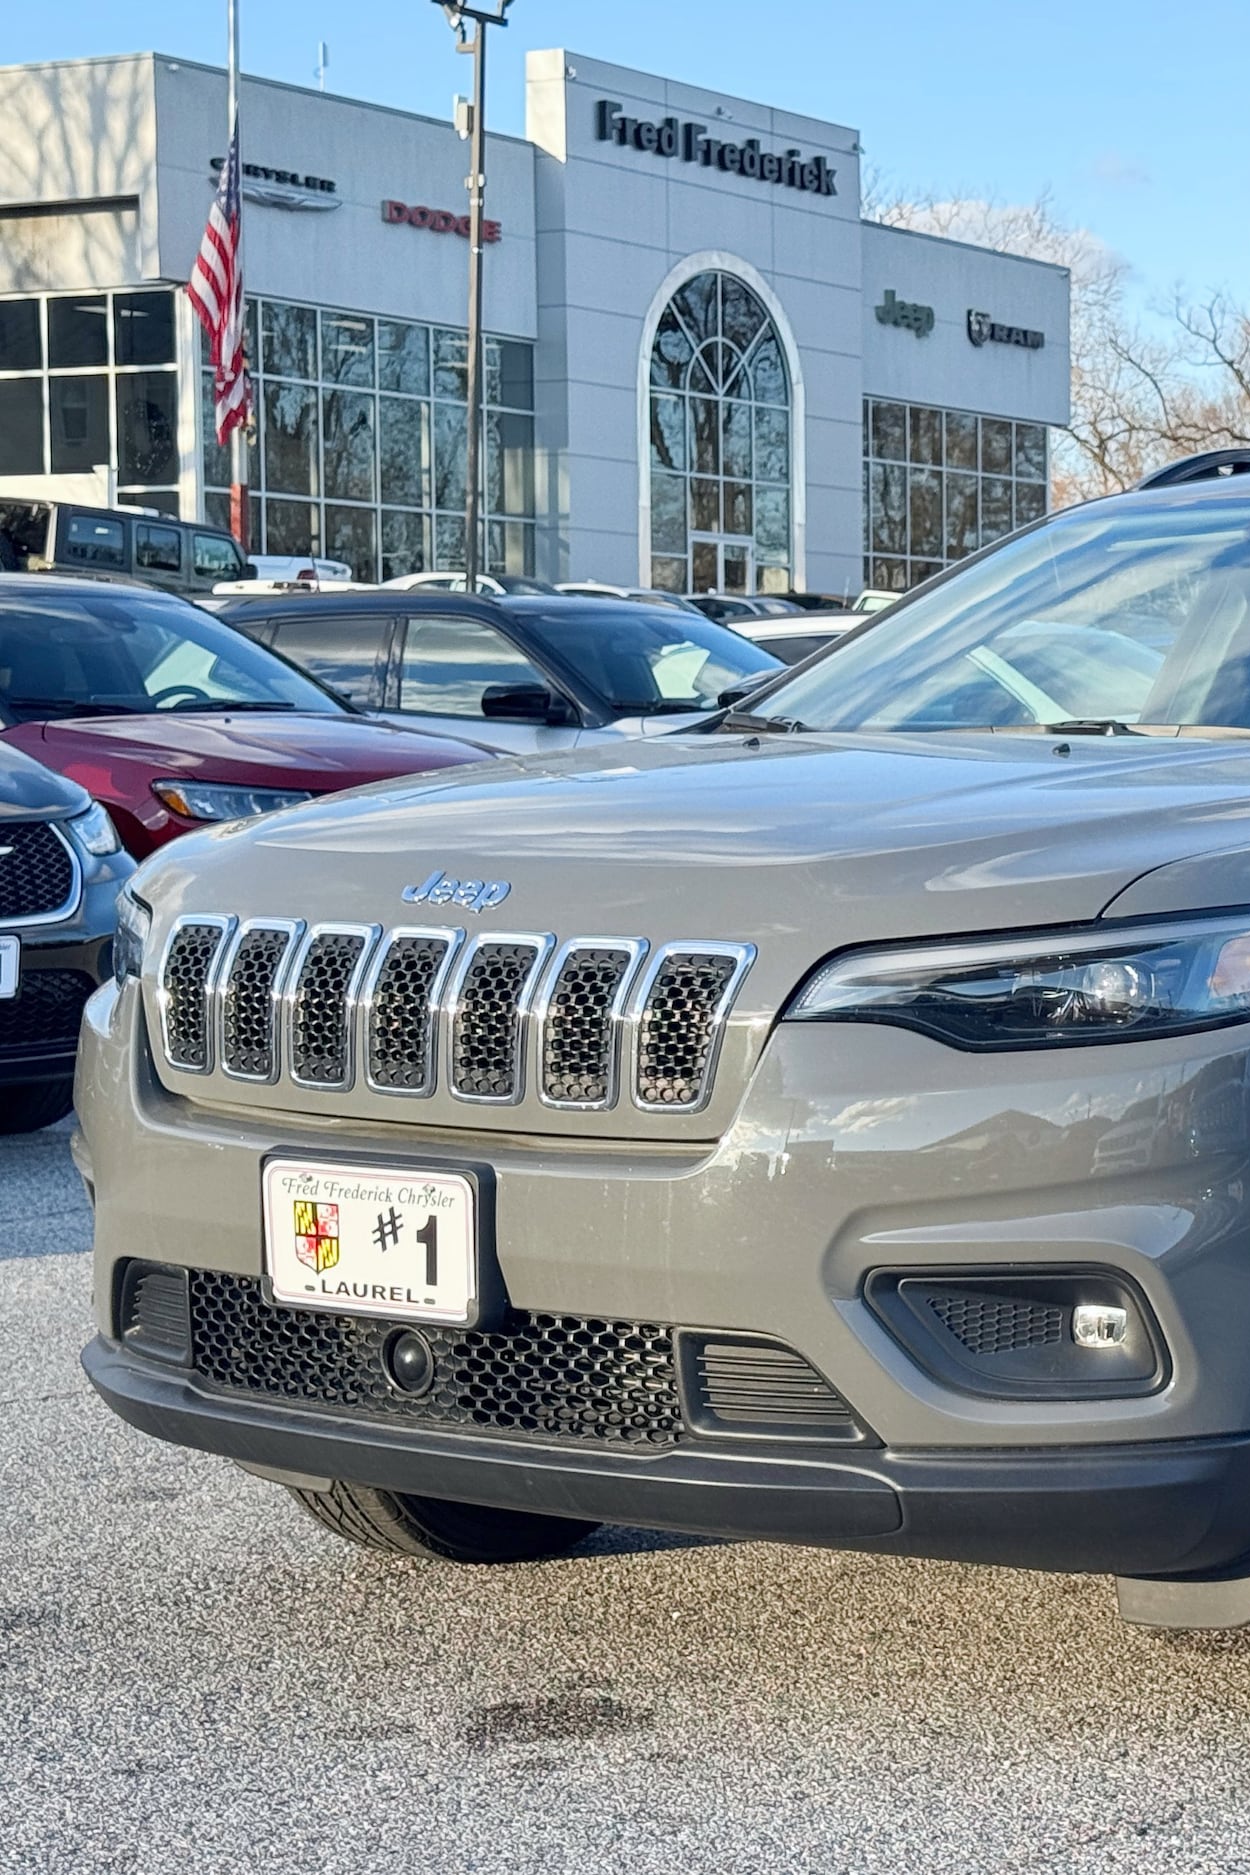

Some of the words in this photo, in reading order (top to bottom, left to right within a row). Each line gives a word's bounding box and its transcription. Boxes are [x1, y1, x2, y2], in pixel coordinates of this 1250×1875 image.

[595, 99, 679, 158] Fred
[681, 122, 837, 196] Frederick
[210, 157, 337, 193] CRYSLER
[381, 199, 502, 243] DODGE
[875, 289, 935, 338] Jeep
[990, 322, 1045, 350] RAM
[401, 869, 513, 914] Jeep
[282, 1176, 320, 1197] Fred
[324, 1180, 393, 1204] Frederick
[397, 1186, 456, 1208] Chrysler
[321, 1278, 420, 1303] LAUREL
